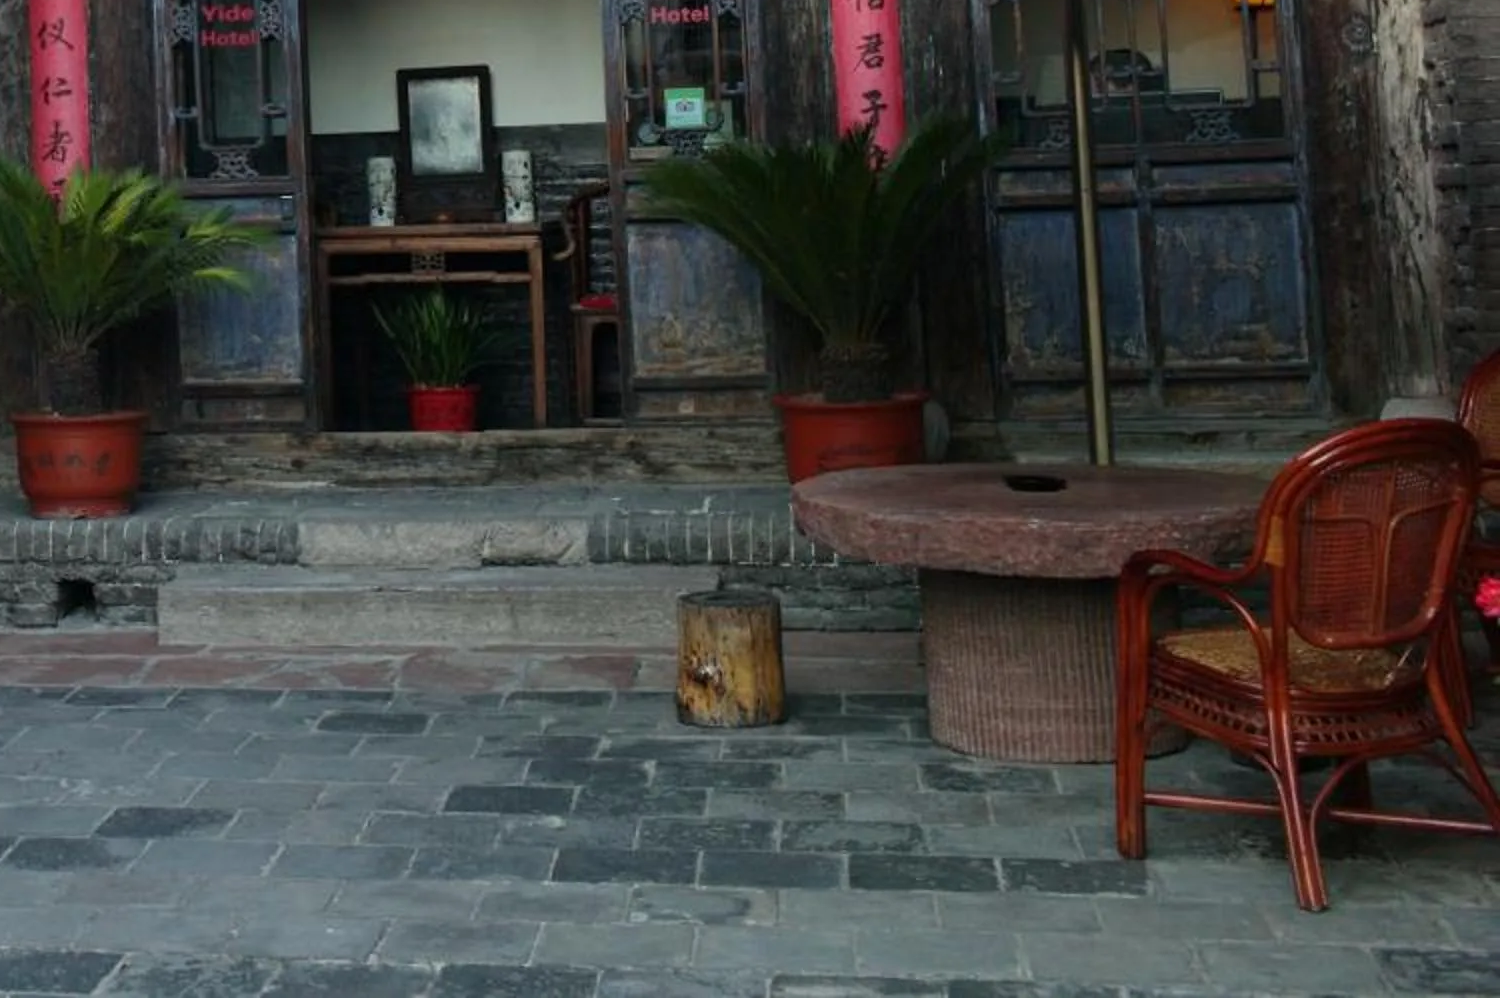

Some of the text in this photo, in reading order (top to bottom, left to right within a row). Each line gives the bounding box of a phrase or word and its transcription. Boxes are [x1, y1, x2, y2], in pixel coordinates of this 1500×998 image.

[201, 4, 255, 22] Yide
[651, 5, 710, 24] Hotel
[201, 30, 259, 47] Hotel
